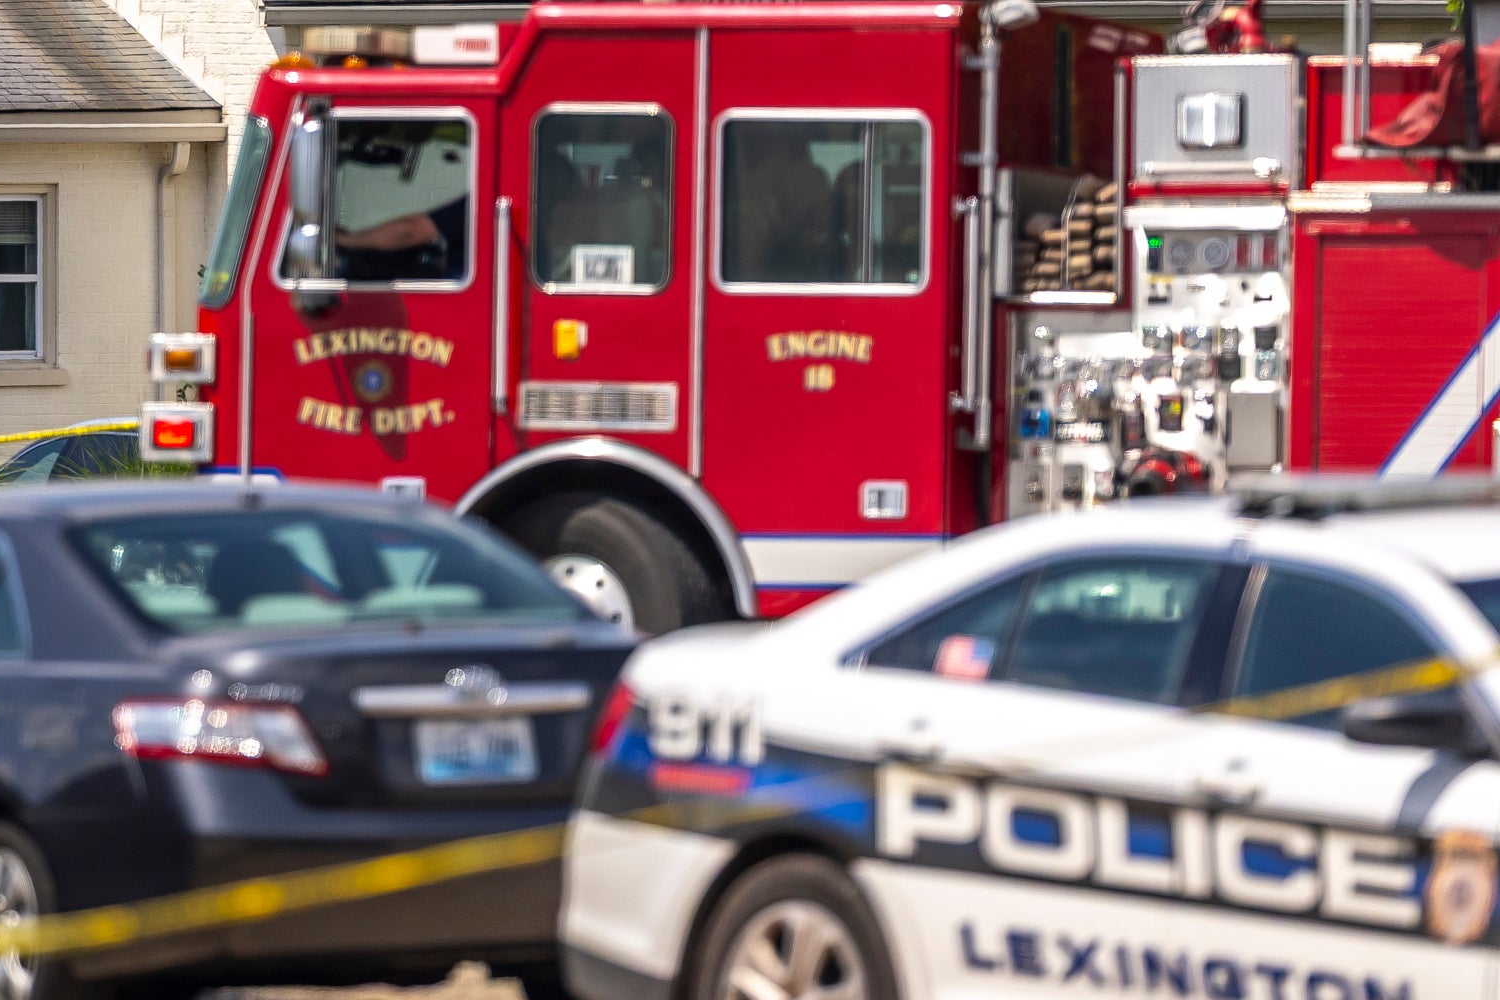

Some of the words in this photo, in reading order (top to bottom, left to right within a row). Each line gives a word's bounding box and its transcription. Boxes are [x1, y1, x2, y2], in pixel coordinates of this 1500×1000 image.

[293, 328, 454, 367] LEXINGTON
[765, 330, 873, 363] ENGINE
[297, 396, 362, 434] FIRE
[371, 398, 456, 435] DEPT.
[647, 690, 764, 766] 911
[875, 764, 1422, 928] POLICE
